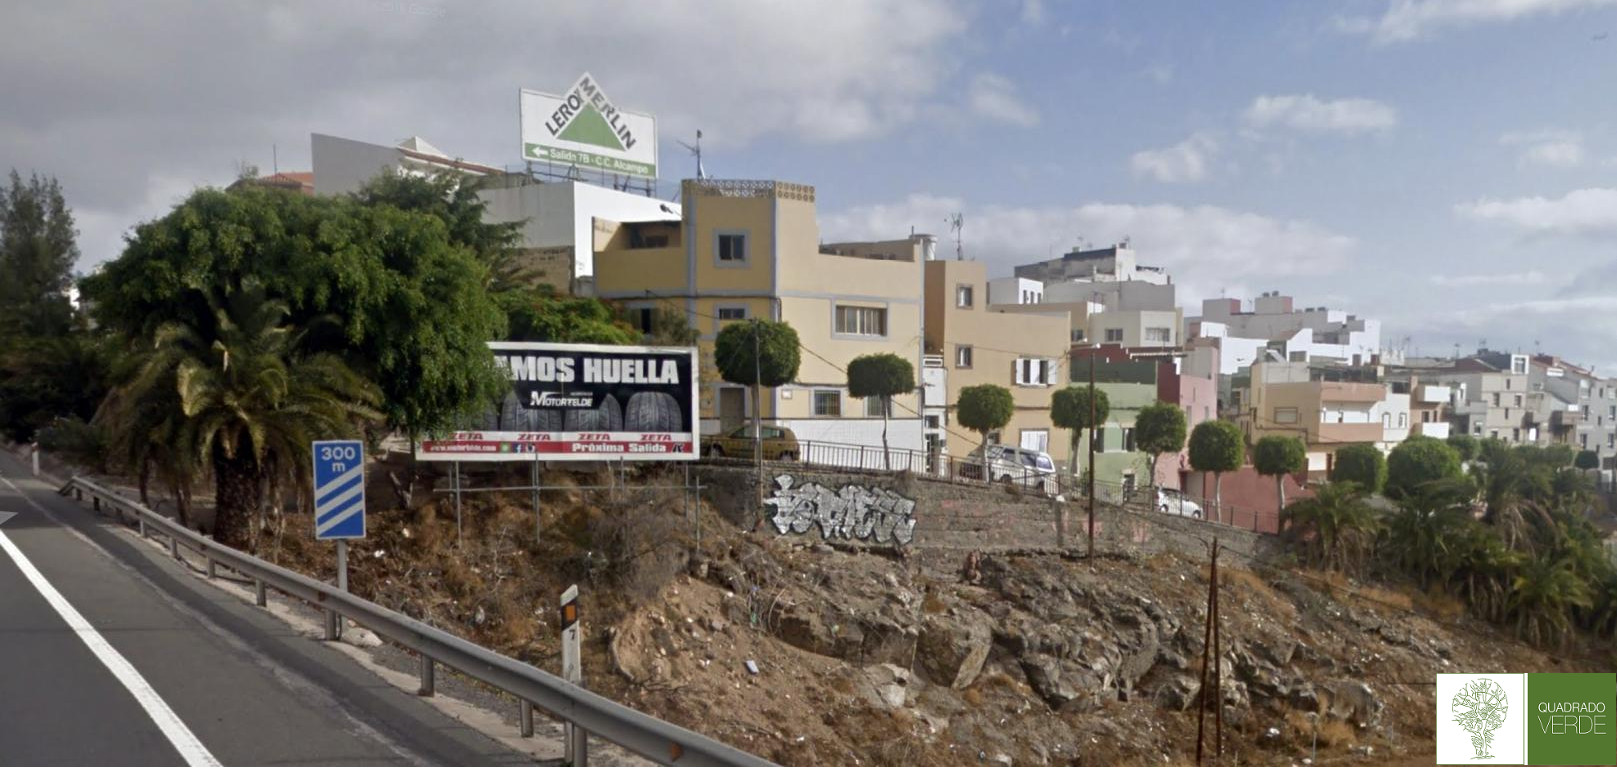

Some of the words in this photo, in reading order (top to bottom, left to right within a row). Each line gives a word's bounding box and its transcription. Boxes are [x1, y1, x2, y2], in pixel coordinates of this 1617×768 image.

[545, 88, 584, 136] LEROY
[580, 76, 636, 149] MERLIN
[614, 160, 649, 174] Alcampo
[583, 357, 680, 384] HUELLA
[450, 432, 484, 441] ZETA
[517, 433, 551, 441] ZETA
[578, 433, 611, 441] ZETA
[572, 442, 625, 453] Próxima
[628, 443, 667, 453] Salida
[321, 446, 356, 461] 300
[332, 462, 346, 472] m
[569, 629, 576, 640] 7
